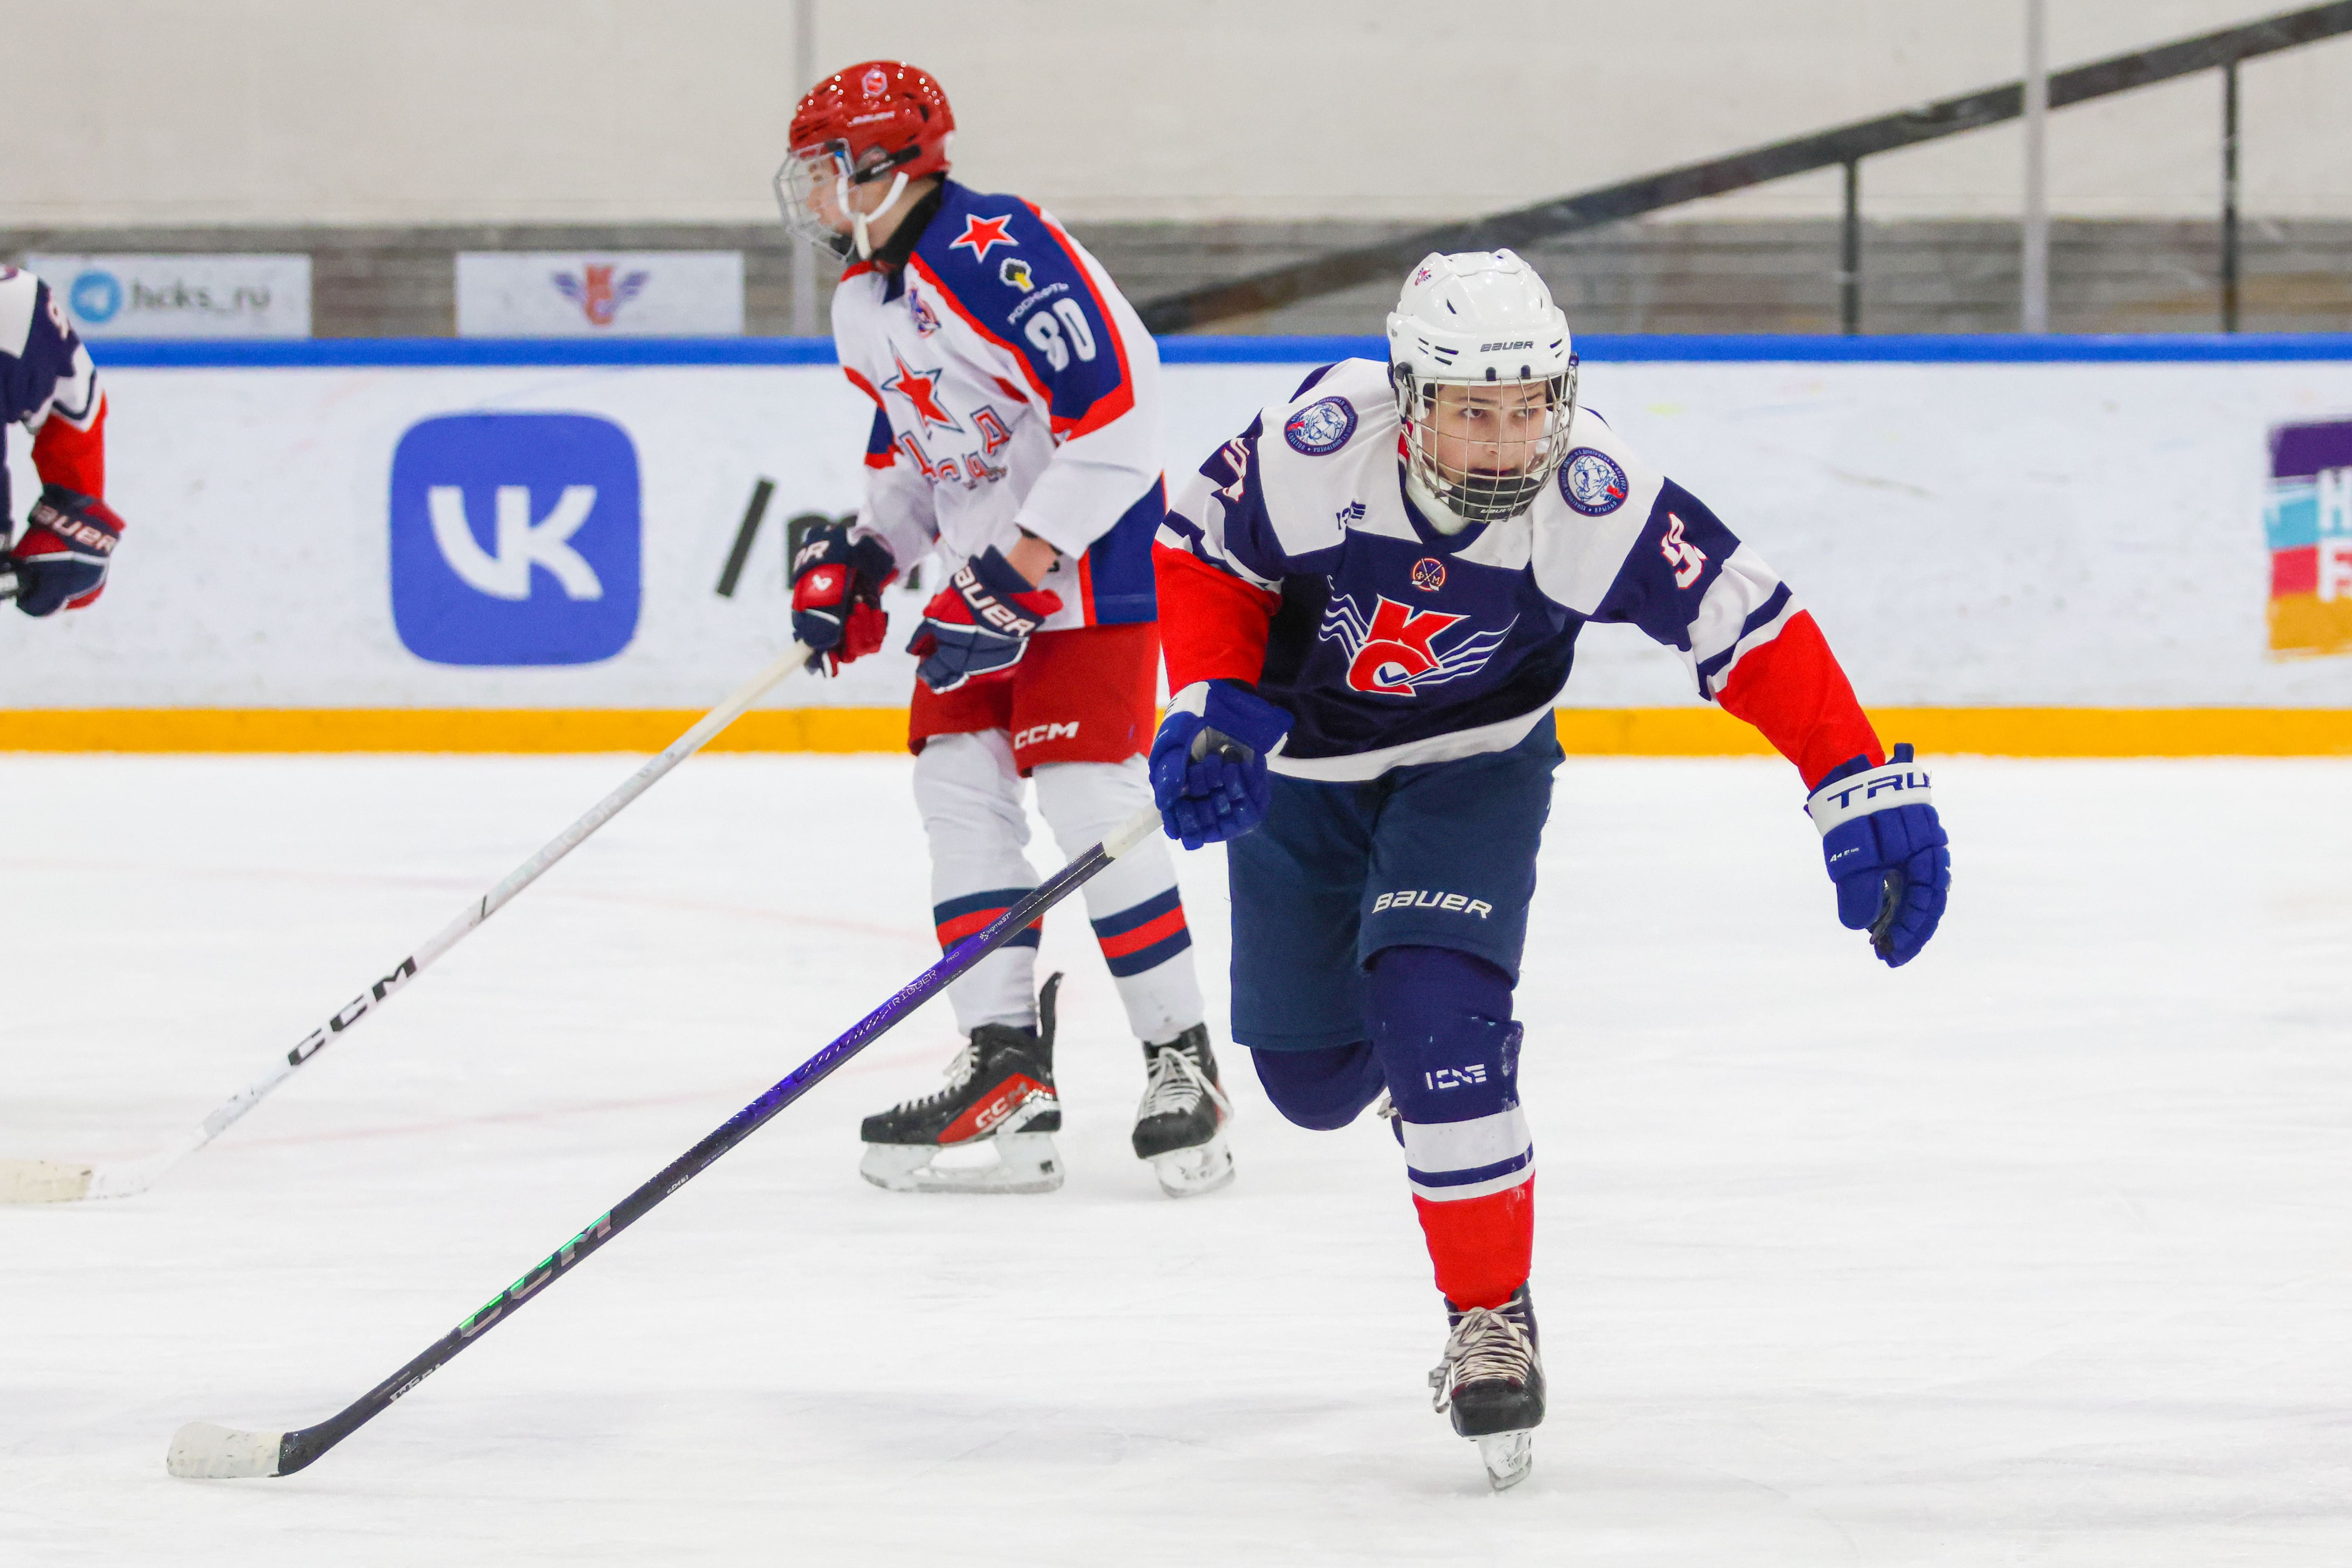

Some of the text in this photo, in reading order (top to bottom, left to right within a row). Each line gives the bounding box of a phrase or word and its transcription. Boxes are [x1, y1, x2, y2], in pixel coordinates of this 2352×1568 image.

[1480, 340, 1534, 352] BAUER
[1015, 721, 1081, 749] CCM
[1372, 890, 1493, 919] BAUER
[946, 951, 960, 964] PRO
[885, 969, 936, 1010] TRIGGER
[288, 955, 417, 1066] CCM
